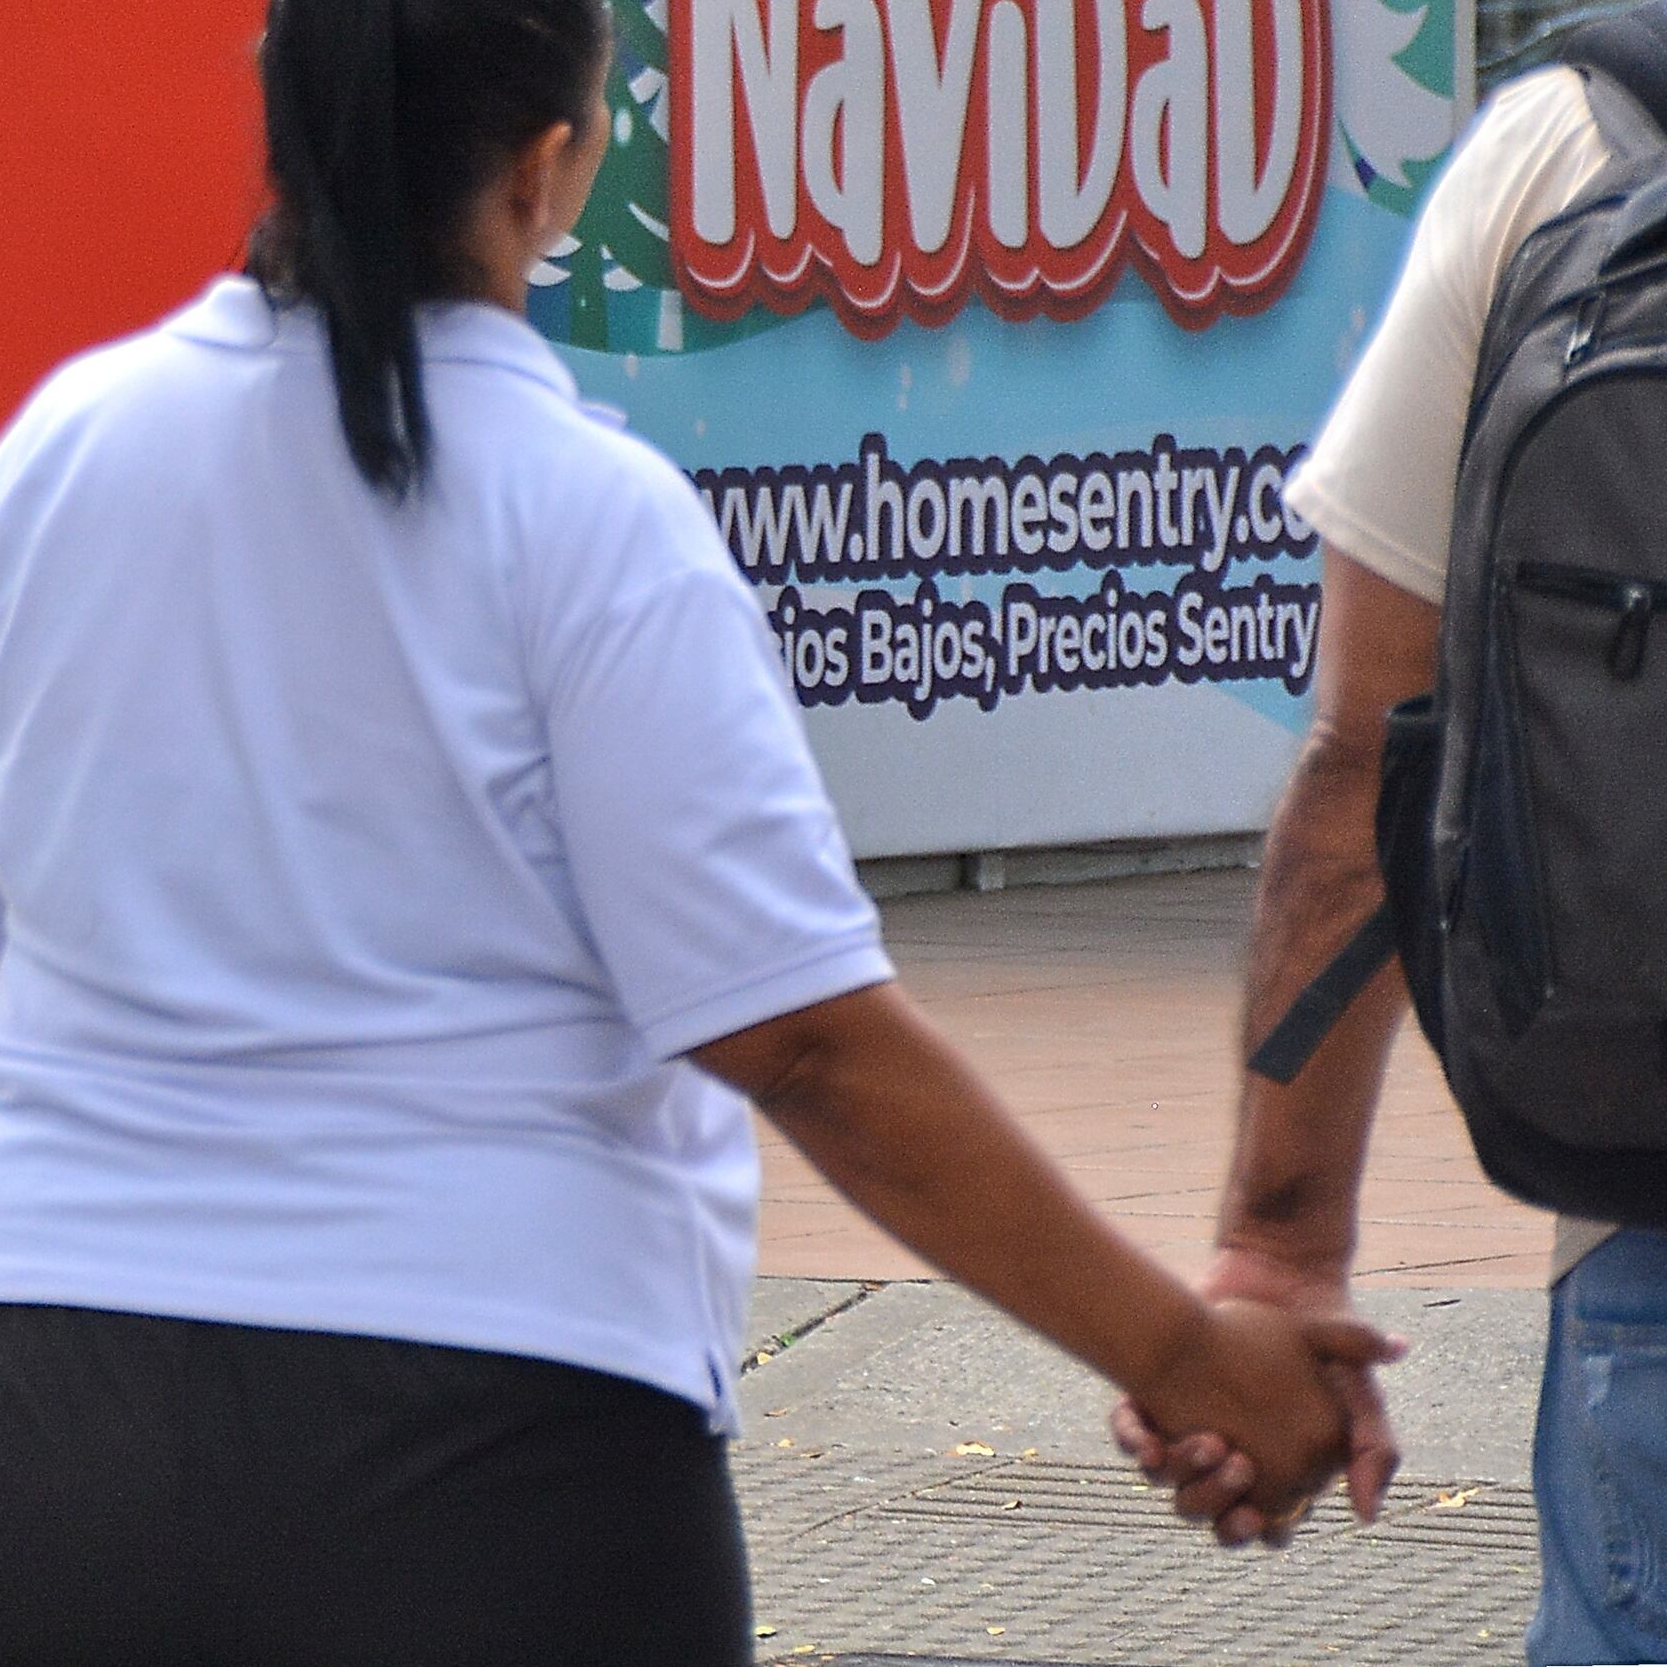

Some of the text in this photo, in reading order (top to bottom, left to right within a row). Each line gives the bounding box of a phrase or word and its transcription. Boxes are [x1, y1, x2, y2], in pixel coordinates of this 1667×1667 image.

[863, 598, 997, 702] Bajos,
[1009, 588, 1167, 677] Precios
[1178, 591, 1319, 678] Sentry
